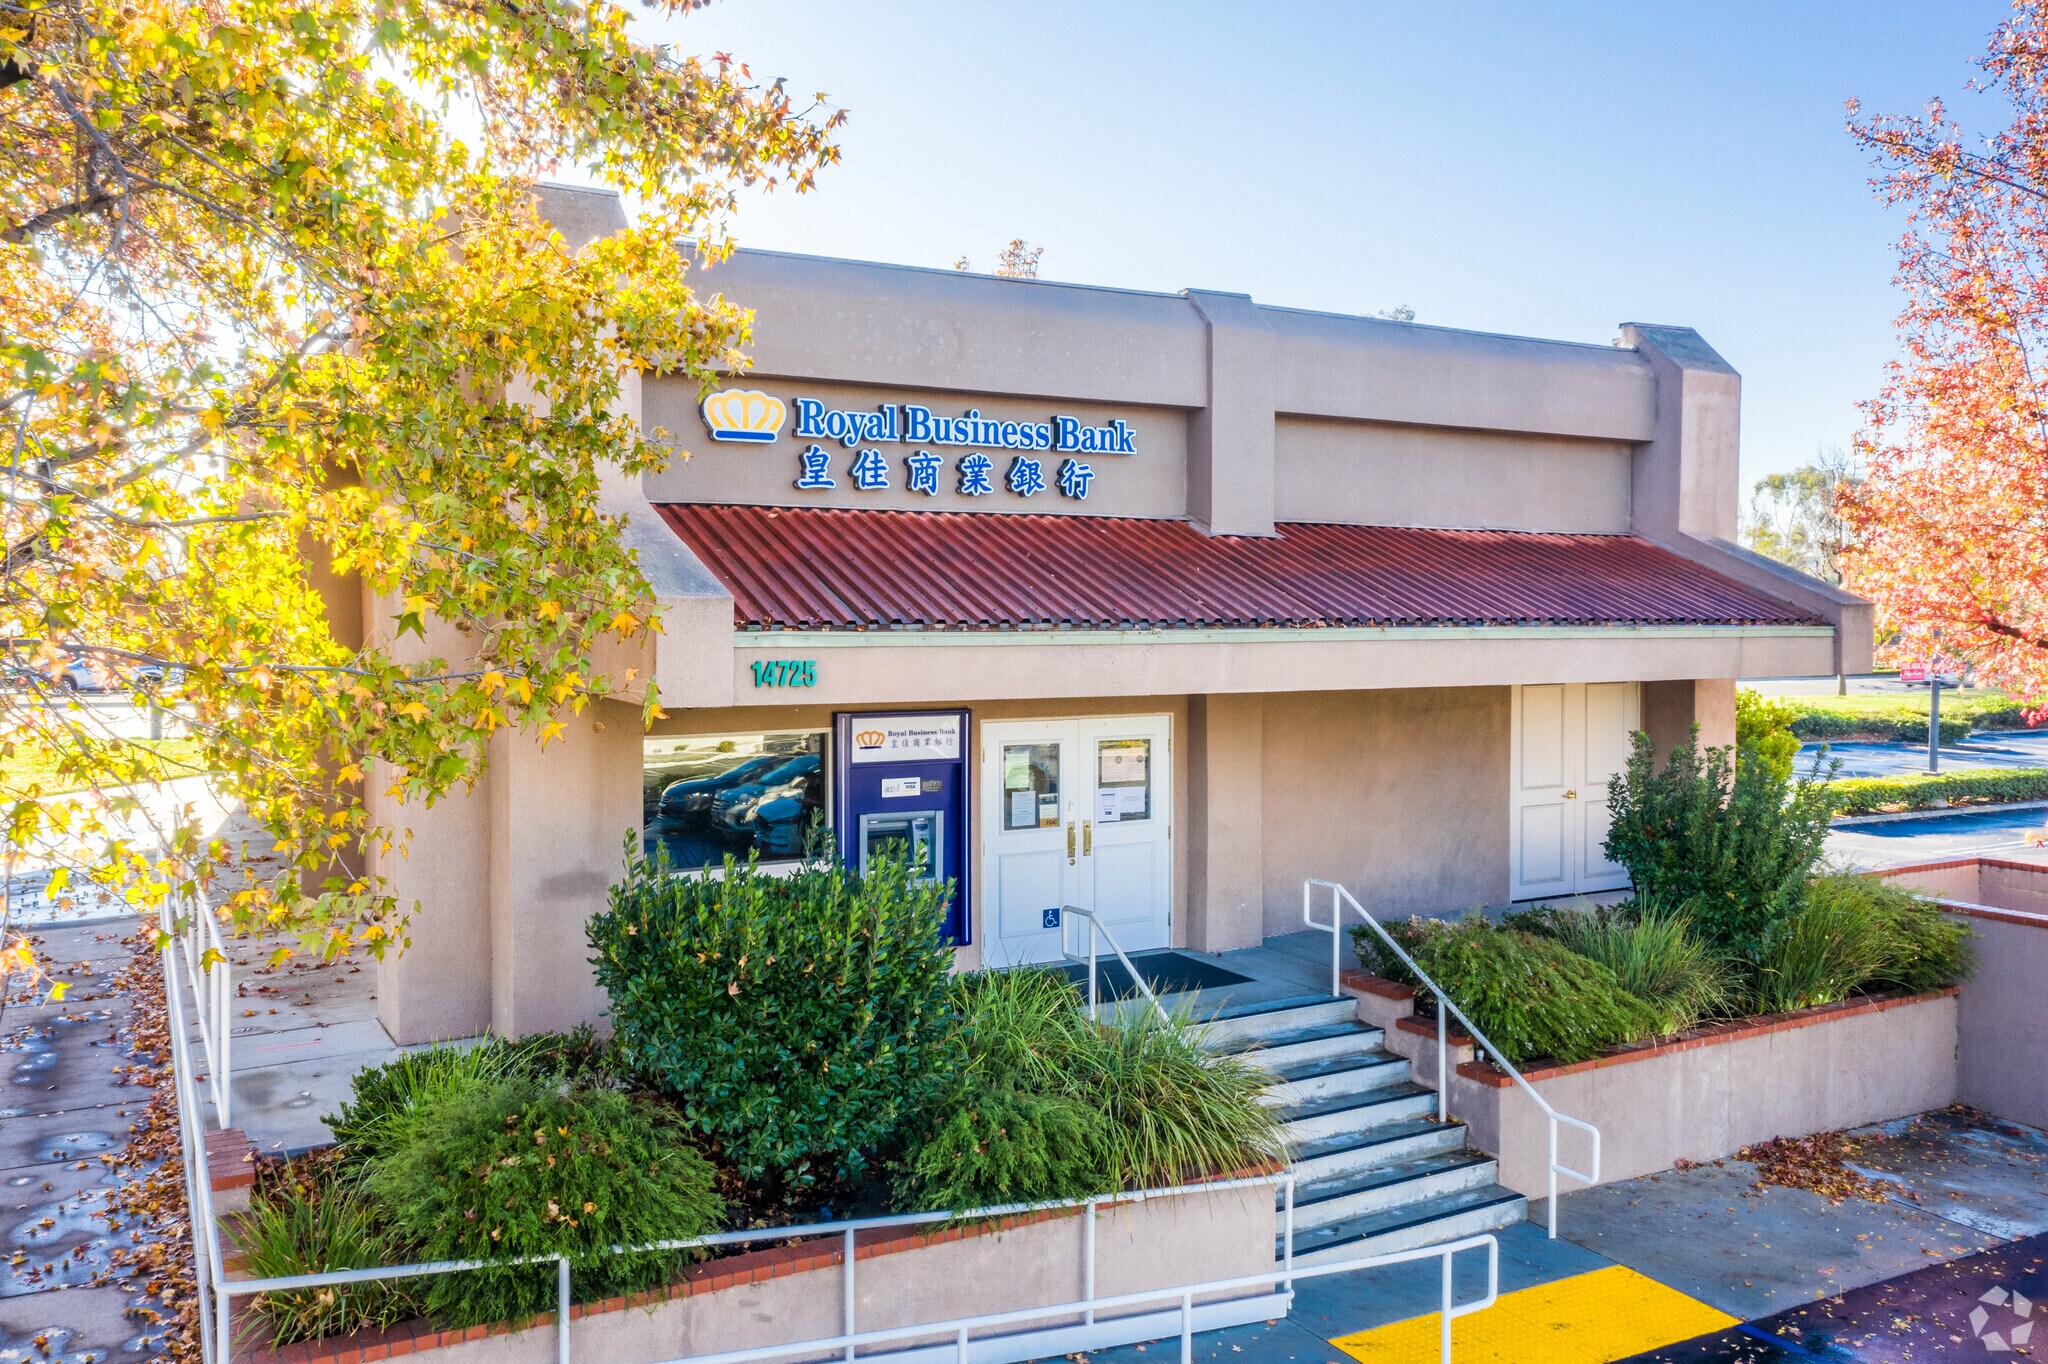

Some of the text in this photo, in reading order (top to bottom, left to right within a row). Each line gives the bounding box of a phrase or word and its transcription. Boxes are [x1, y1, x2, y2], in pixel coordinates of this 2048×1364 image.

[796, 397, 1138, 454] Royal Business Bank
[797, 443, 1097, 500] 皇佳商業銀行
[751, 659, 817, 688] 14725
[888, 730, 907, 738] Royal
